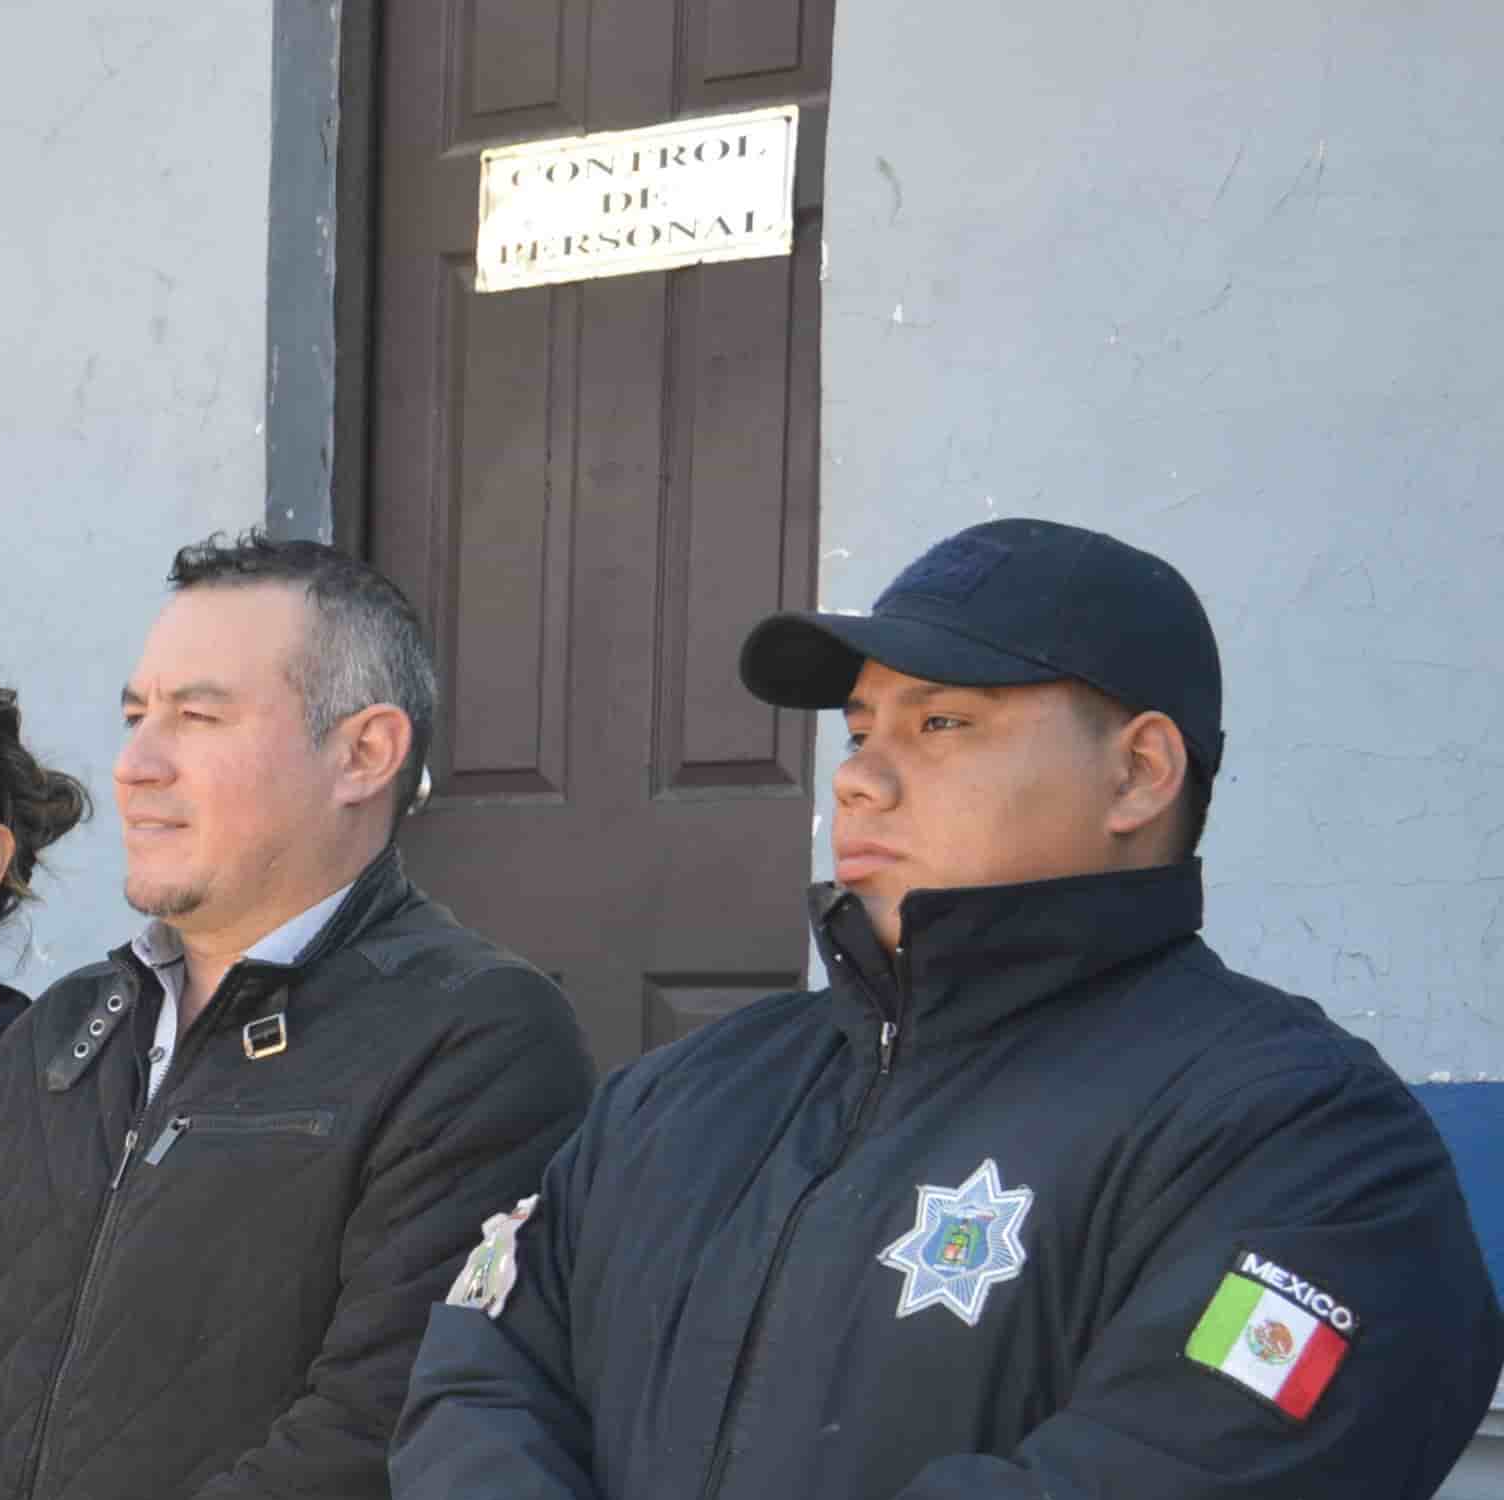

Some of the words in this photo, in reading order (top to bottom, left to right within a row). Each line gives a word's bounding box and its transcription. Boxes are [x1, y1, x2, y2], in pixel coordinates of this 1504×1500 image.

[510, 134, 768, 188] CONTROL
[601, 187, 669, 214] DE
[498, 210, 775, 265] PERSONAL
[1240, 1252, 1355, 1332] MEXICO
